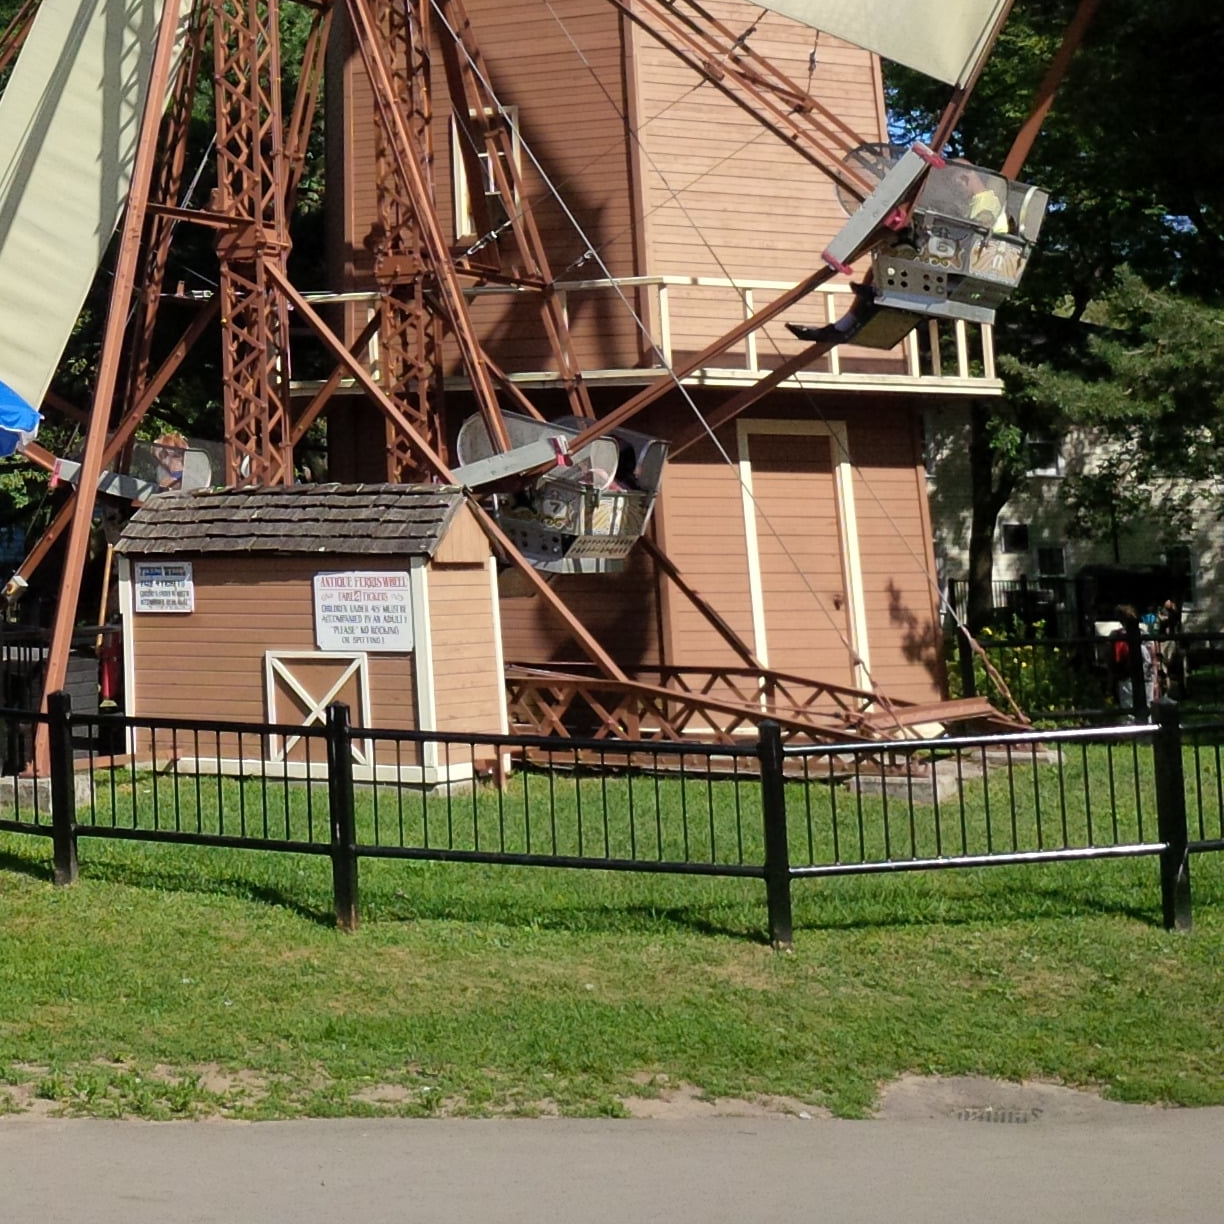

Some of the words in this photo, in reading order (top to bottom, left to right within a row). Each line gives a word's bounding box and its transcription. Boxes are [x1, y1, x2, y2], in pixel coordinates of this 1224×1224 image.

[936, 241, 948, 252] 6
[550, 502, 561, 514] 7
[321, 576, 352, 588] ANTIQUE
[354, 576, 381, 588] FERRIS
[363, 591, 389, 602] TICKETS
[321, 605, 347, 613] CHILDREN
[349, 605, 368, 613] UNDER
[321, 615, 362, 624] ACCOMPANIED
[373, 615, 381, 624] AN
[360, 625, 369, 635] NO
